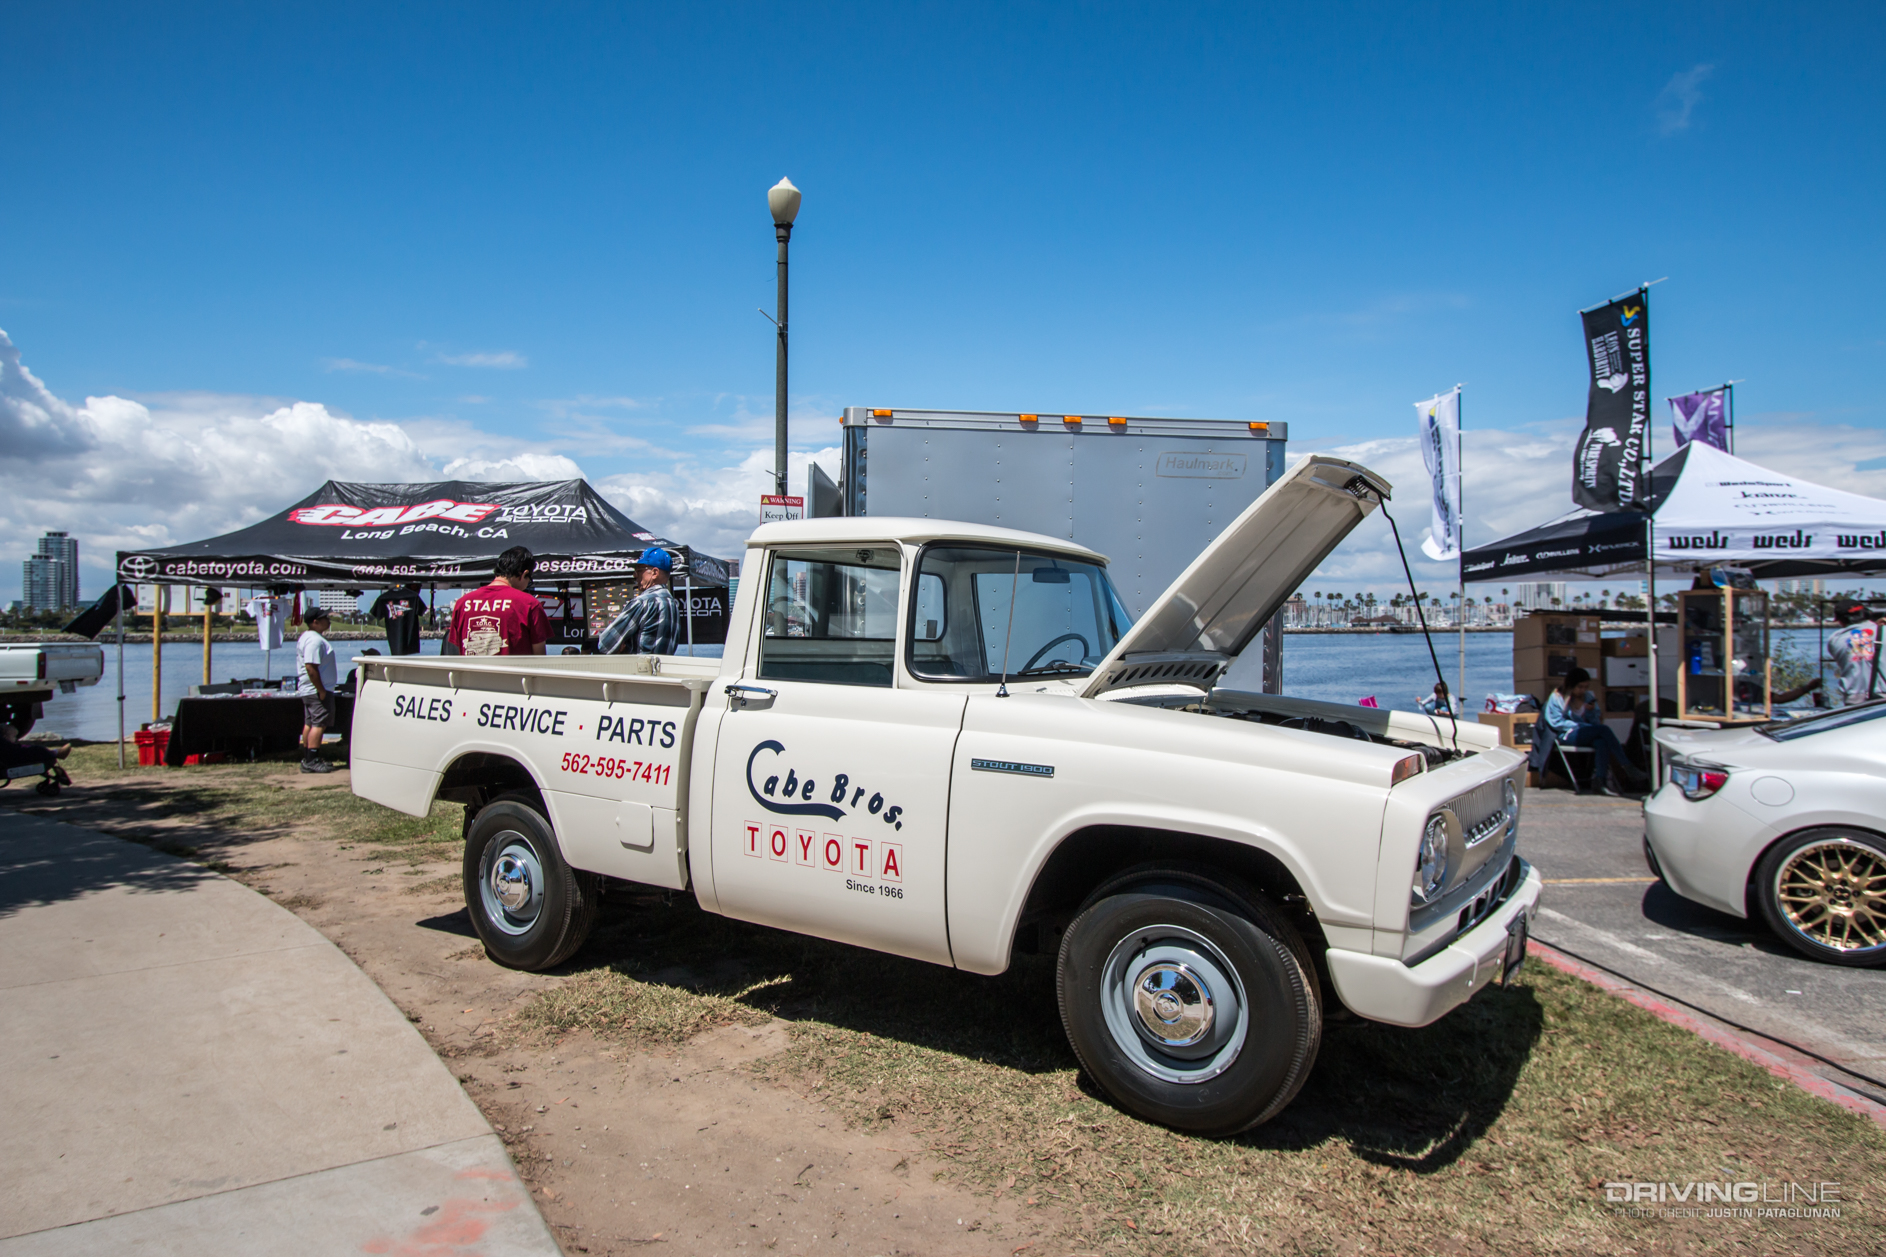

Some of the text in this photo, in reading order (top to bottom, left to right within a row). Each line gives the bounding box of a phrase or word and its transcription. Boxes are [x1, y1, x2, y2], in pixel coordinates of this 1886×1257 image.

[1627, 328, 1646, 387] SUPER
[1631, 391, 1646, 435] STAR
[1166, 456, 1235, 471] Haulmark
[770, 497, 802, 505] WARNING
[287, 499, 588, 527] CABE TOYOTA
[765, 511, 799, 521] Keep Off
[341, 523, 508, 540] Long Beach, CA
[1836, 530, 1886, 549] wed
[165, 560, 307, 578] cabetoyota.com
[464, 599, 512, 612] STAFF
[563, 625, 585, 638] Lo
[393, 694, 677, 749] SALES SERVICE PARTS
[560, 752, 671, 786] 562-595-7411
[972, 760, 1053, 774] STOUT 1900
[746, 739, 903, 832] Cabe Bros.
[746, 825, 901, 879] TOYOTA
[846, 879, 904, 899] Since 1966
